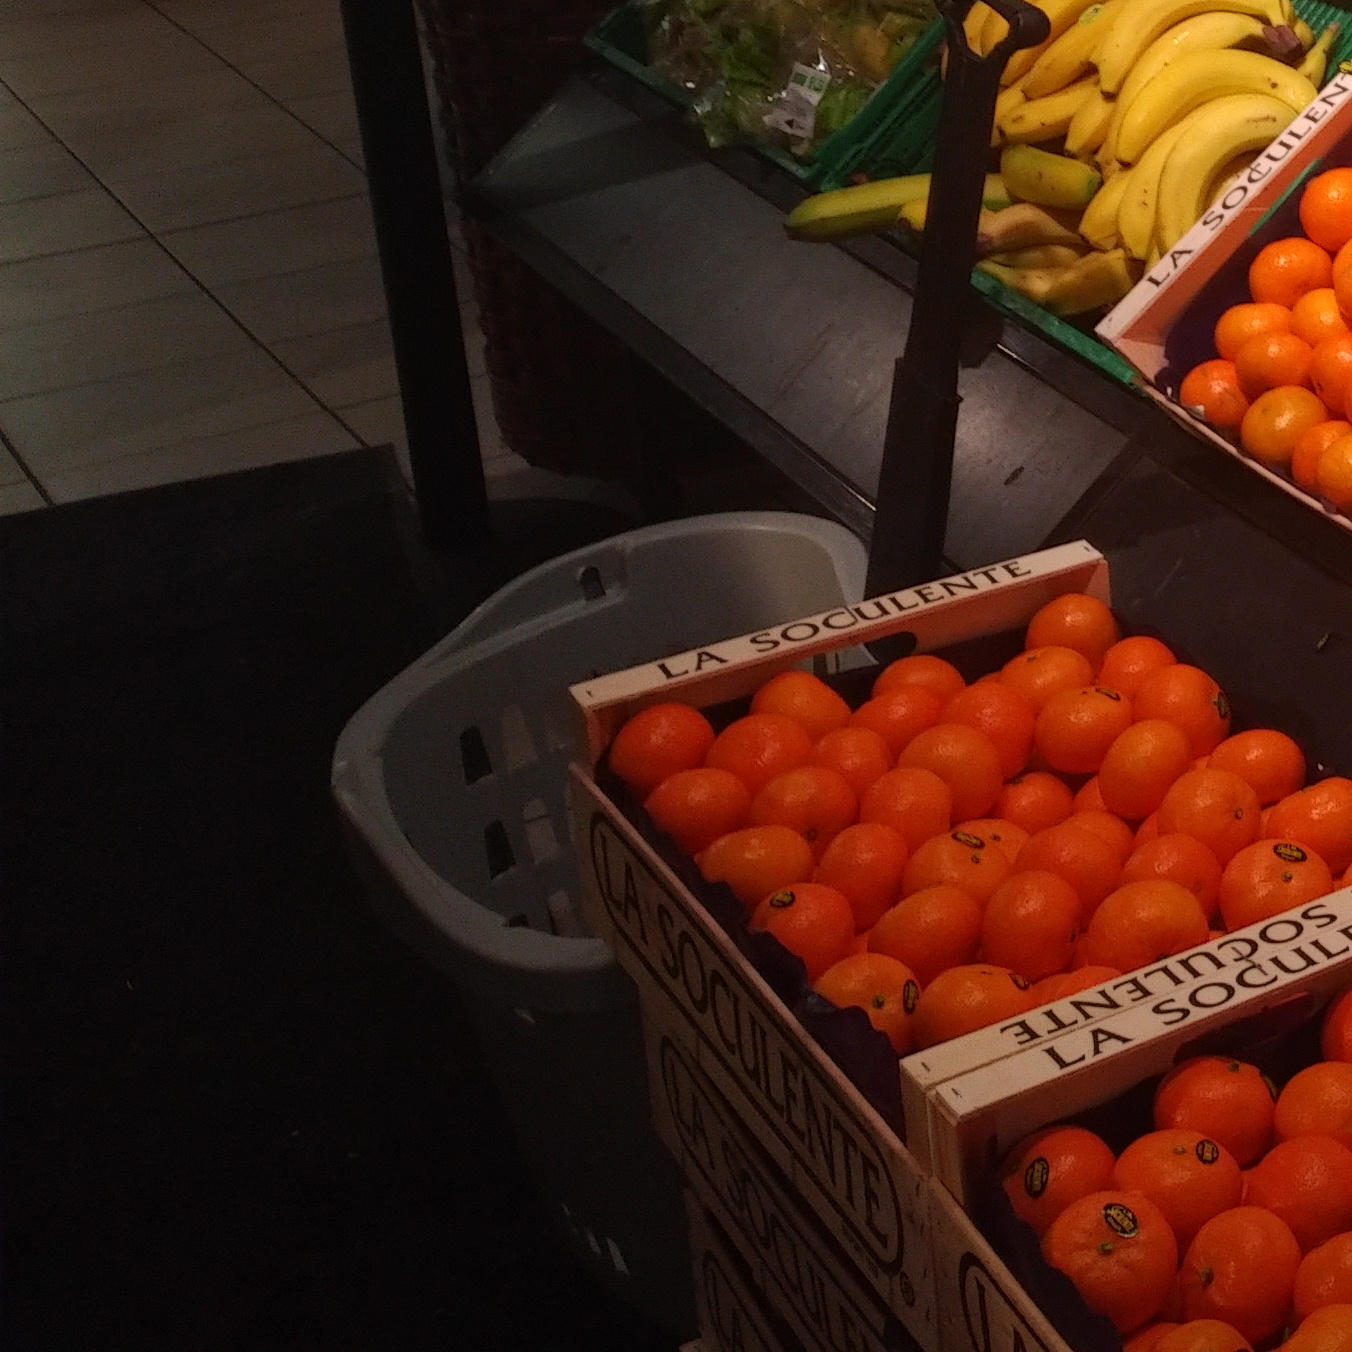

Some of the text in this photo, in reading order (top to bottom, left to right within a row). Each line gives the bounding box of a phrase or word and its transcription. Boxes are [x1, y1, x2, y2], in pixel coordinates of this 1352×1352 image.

[1146, 246, 1194, 289] LA
[657, 561, 1032, 680] LA SOCULENTE
[998, 904, 1340, 1045] SOCULENTE
[602, 833, 889, 1251] LA SOCULENTE
[1043, 1026, 1134, 1071] LA
